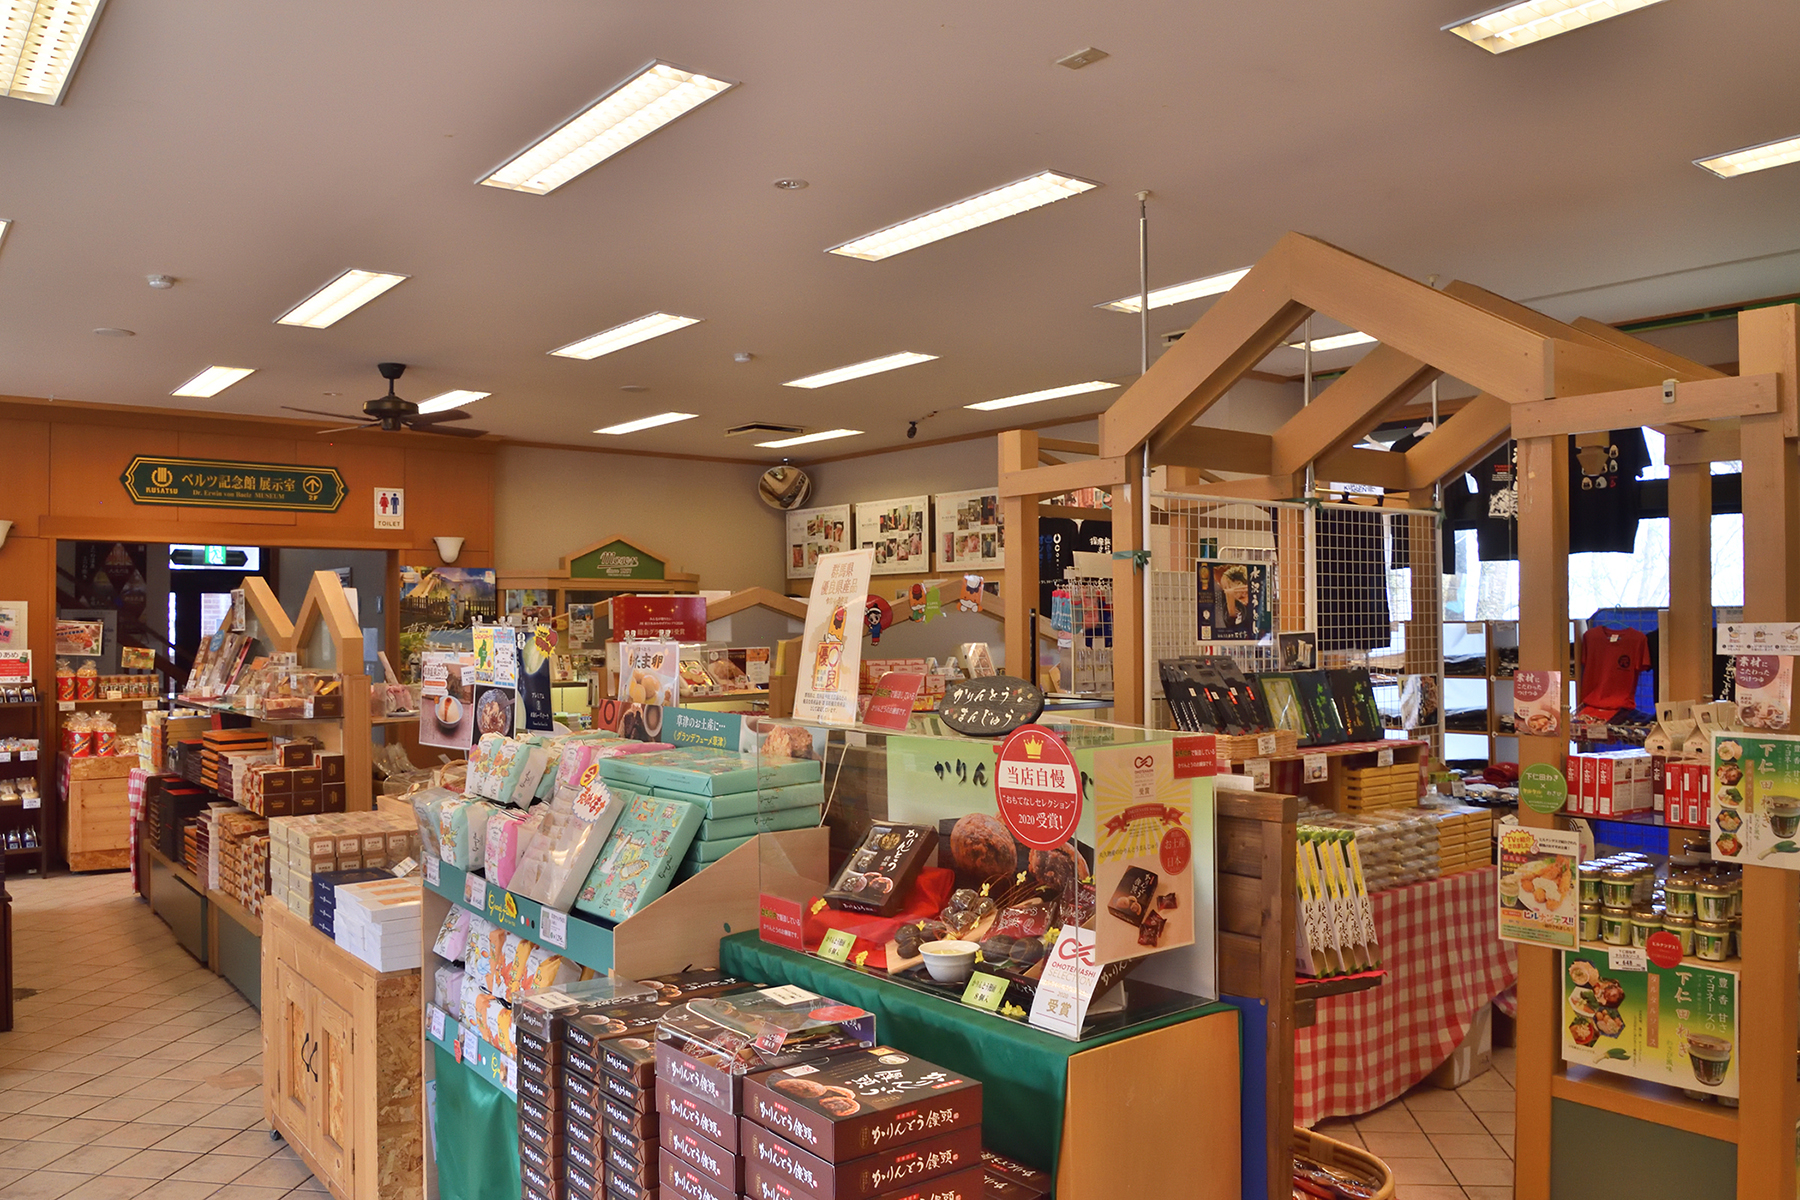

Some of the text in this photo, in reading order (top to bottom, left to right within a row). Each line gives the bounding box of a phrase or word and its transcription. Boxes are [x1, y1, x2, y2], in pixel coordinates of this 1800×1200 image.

[181, 473, 296, 492] ベルツ記念館 展示室
[254, 492, 285, 500] MUSEUM
[1250, 565, 1261, 634] 水沢うどん
[1739, 656, 1768, 668] 素材に
[1516, 673, 1540, 683] 素材に
[953, 687, 1010, 705] かりんとう
[957, 707, 1014, 728] まんじゅう
[1007, 766, 1065, 789] 当店自慢
[1139, 787, 1150, 795] 受賞
[1018, 813, 1035, 825] 2020
[886, 829, 919, 872] かりんとう
[1165, 837, 1186, 850] お土産
[1167, 856, 1182, 867] 日本
[1046, 998, 1072, 1018] 受賞
[860, 1071, 947, 1096] かりんとう
[759, 1101, 814, 1145] かりんとう饅頭
[871, 1107, 954, 1145] かりんとう饅頭
[758, 1142, 814, 1189] かりんとう饅頭
[871, 1149, 953, 1189] かりんとう饅頭
